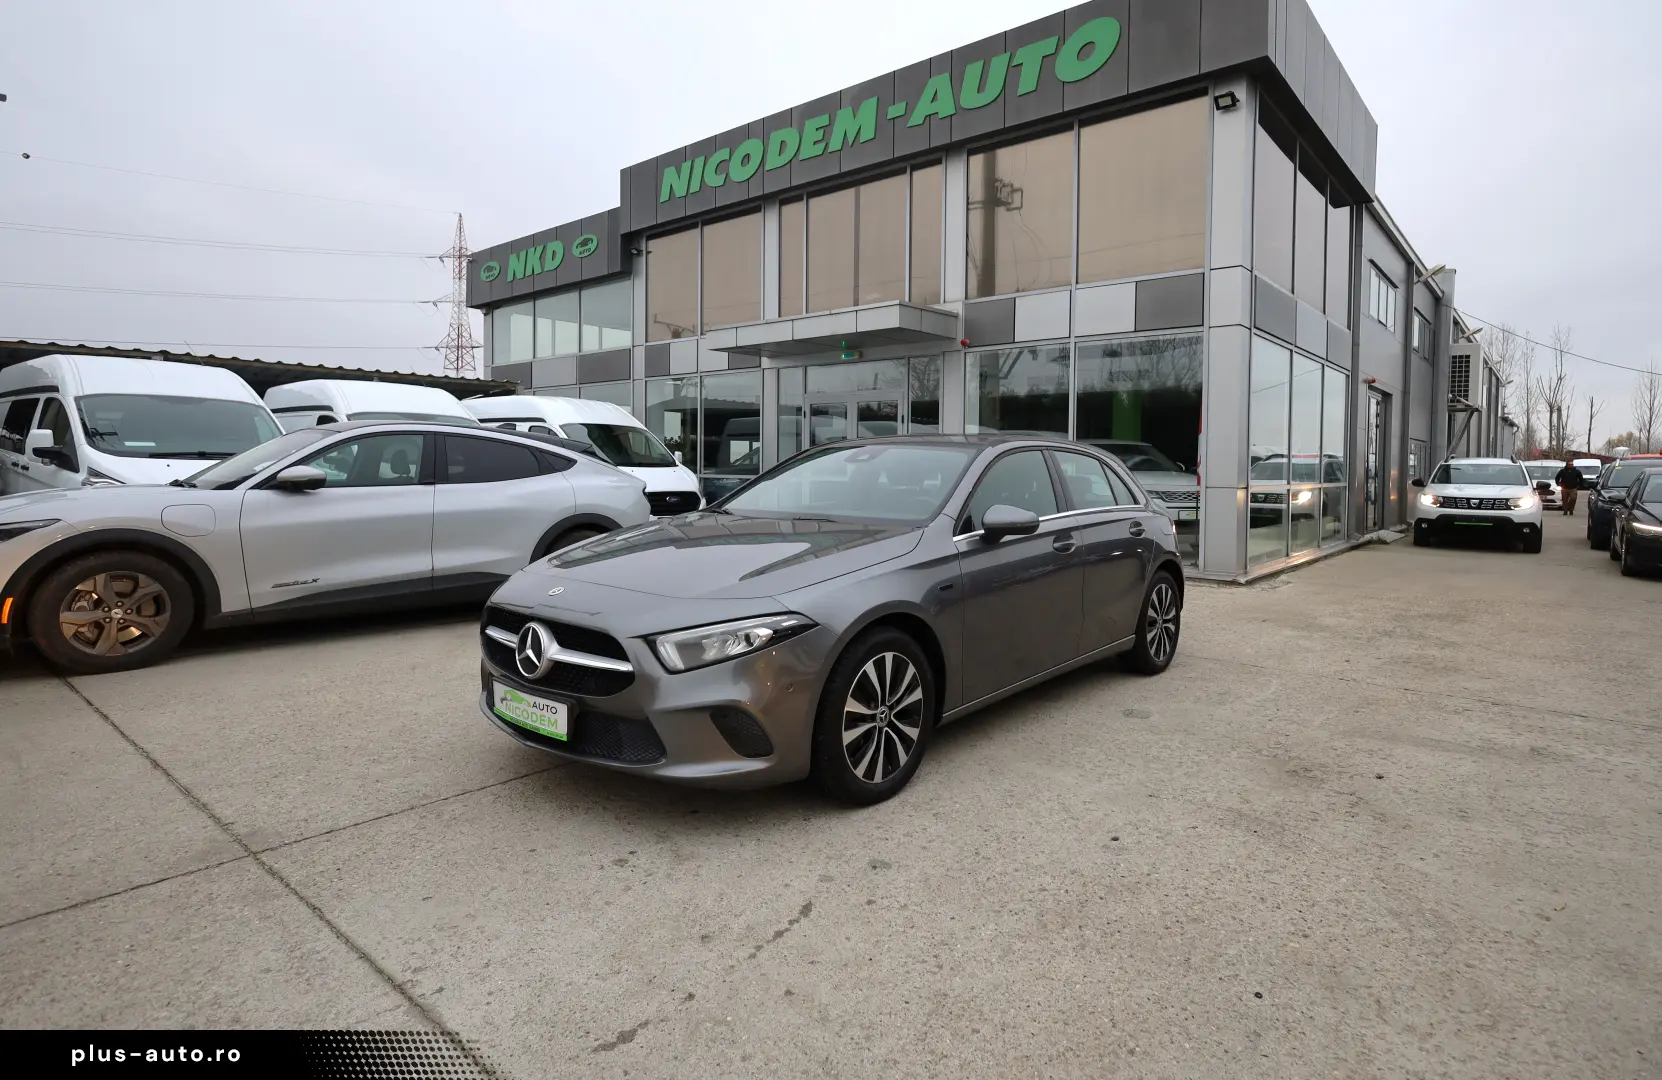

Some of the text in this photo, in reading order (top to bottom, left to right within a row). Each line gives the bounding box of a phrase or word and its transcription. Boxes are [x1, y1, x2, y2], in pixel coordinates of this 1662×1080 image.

[507, 241, 565, 282] NKD
[505, 702, 558, 729] NICODEM
[532, 701, 558, 714] AUTO
